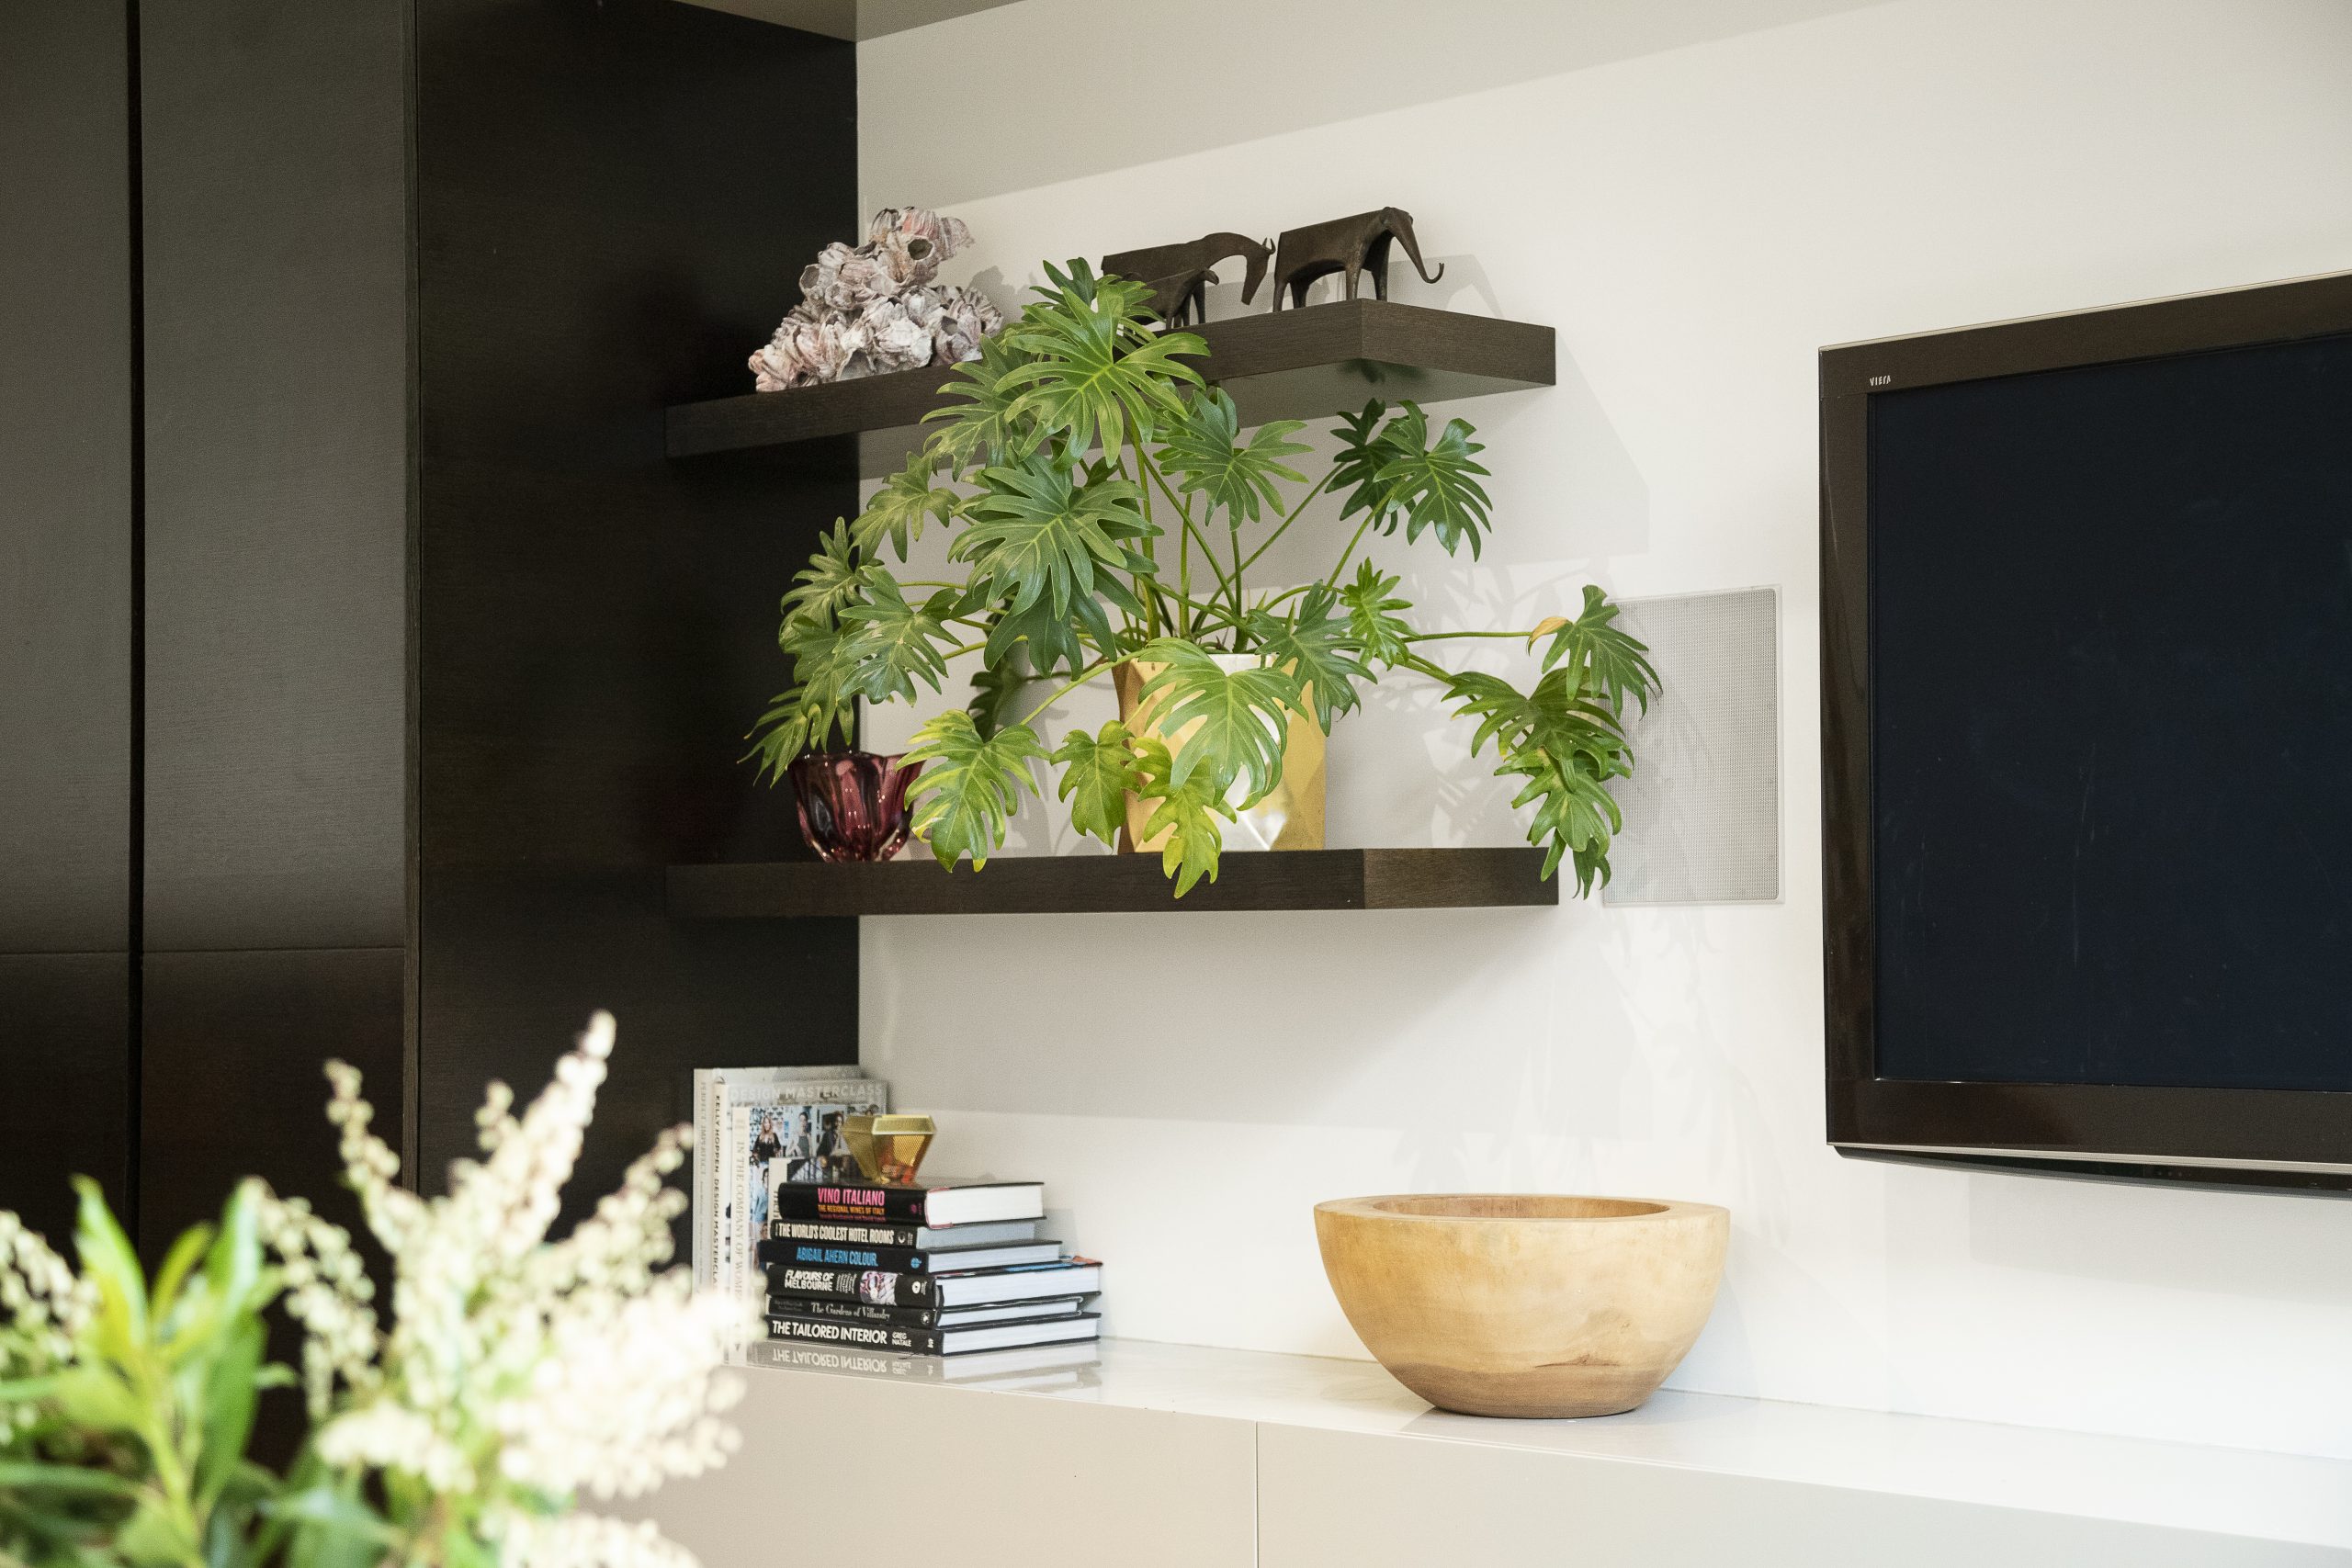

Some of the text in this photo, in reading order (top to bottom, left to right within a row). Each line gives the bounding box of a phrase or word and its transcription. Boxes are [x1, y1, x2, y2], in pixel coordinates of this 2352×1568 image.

[729, 1082, 883, 1101] DESIGN MASTERCLASS
[736, 1142, 745, 1154] IN
[736, 1156, 745, 1181] THE
[817, 1187, 886, 1206] VINO ITALIANO
[735, 1184, 744, 1239] COMPANY
[778, 1223, 791, 1238] THE
[791, 1224, 819, 1240] WORLD'S
[819, 1224, 848, 1242] COOLEST
[848, 1227, 869, 1243] HOTEL
[869, 1228, 895, 1245] ROOMS
[735, 1242, 743, 1258] OF
[796, 1247, 823, 1262] ABIGAIL
[824, 1248, 849, 1264] AHERN
[785, 1269, 835, 1282] FLAVOURS OF
[784, 1279, 833, 1292] MELBOURNE
[810, 1302, 825, 1315] The
[825, 1303, 853, 1316] Gardens
[853, 1306, 862, 1317] of
[772, 1320, 888, 1345] THE TAILORED INTERIOR
[891, 1331, 908, 1340] GREG
[891, 1338, 911, 1348] NATALE
